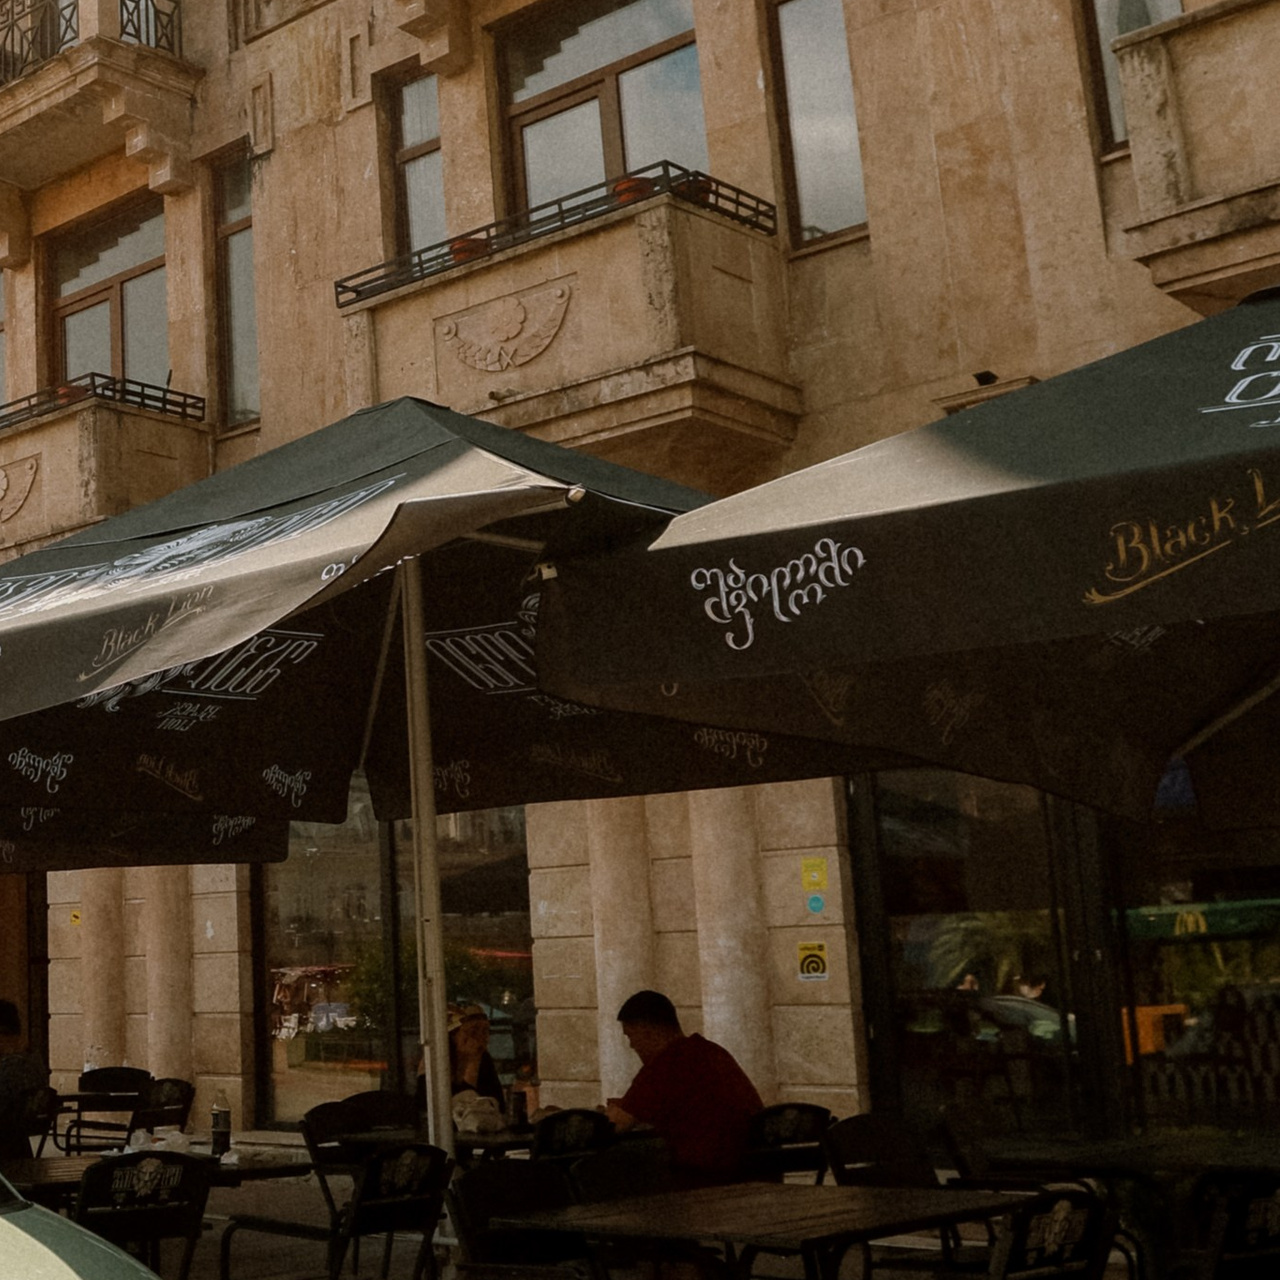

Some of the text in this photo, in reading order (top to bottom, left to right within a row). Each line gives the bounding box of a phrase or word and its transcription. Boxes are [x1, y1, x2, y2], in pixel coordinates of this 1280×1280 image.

[1105, 497, 1249, 582] Black
[91, 584, 214, 668] Black Lion
